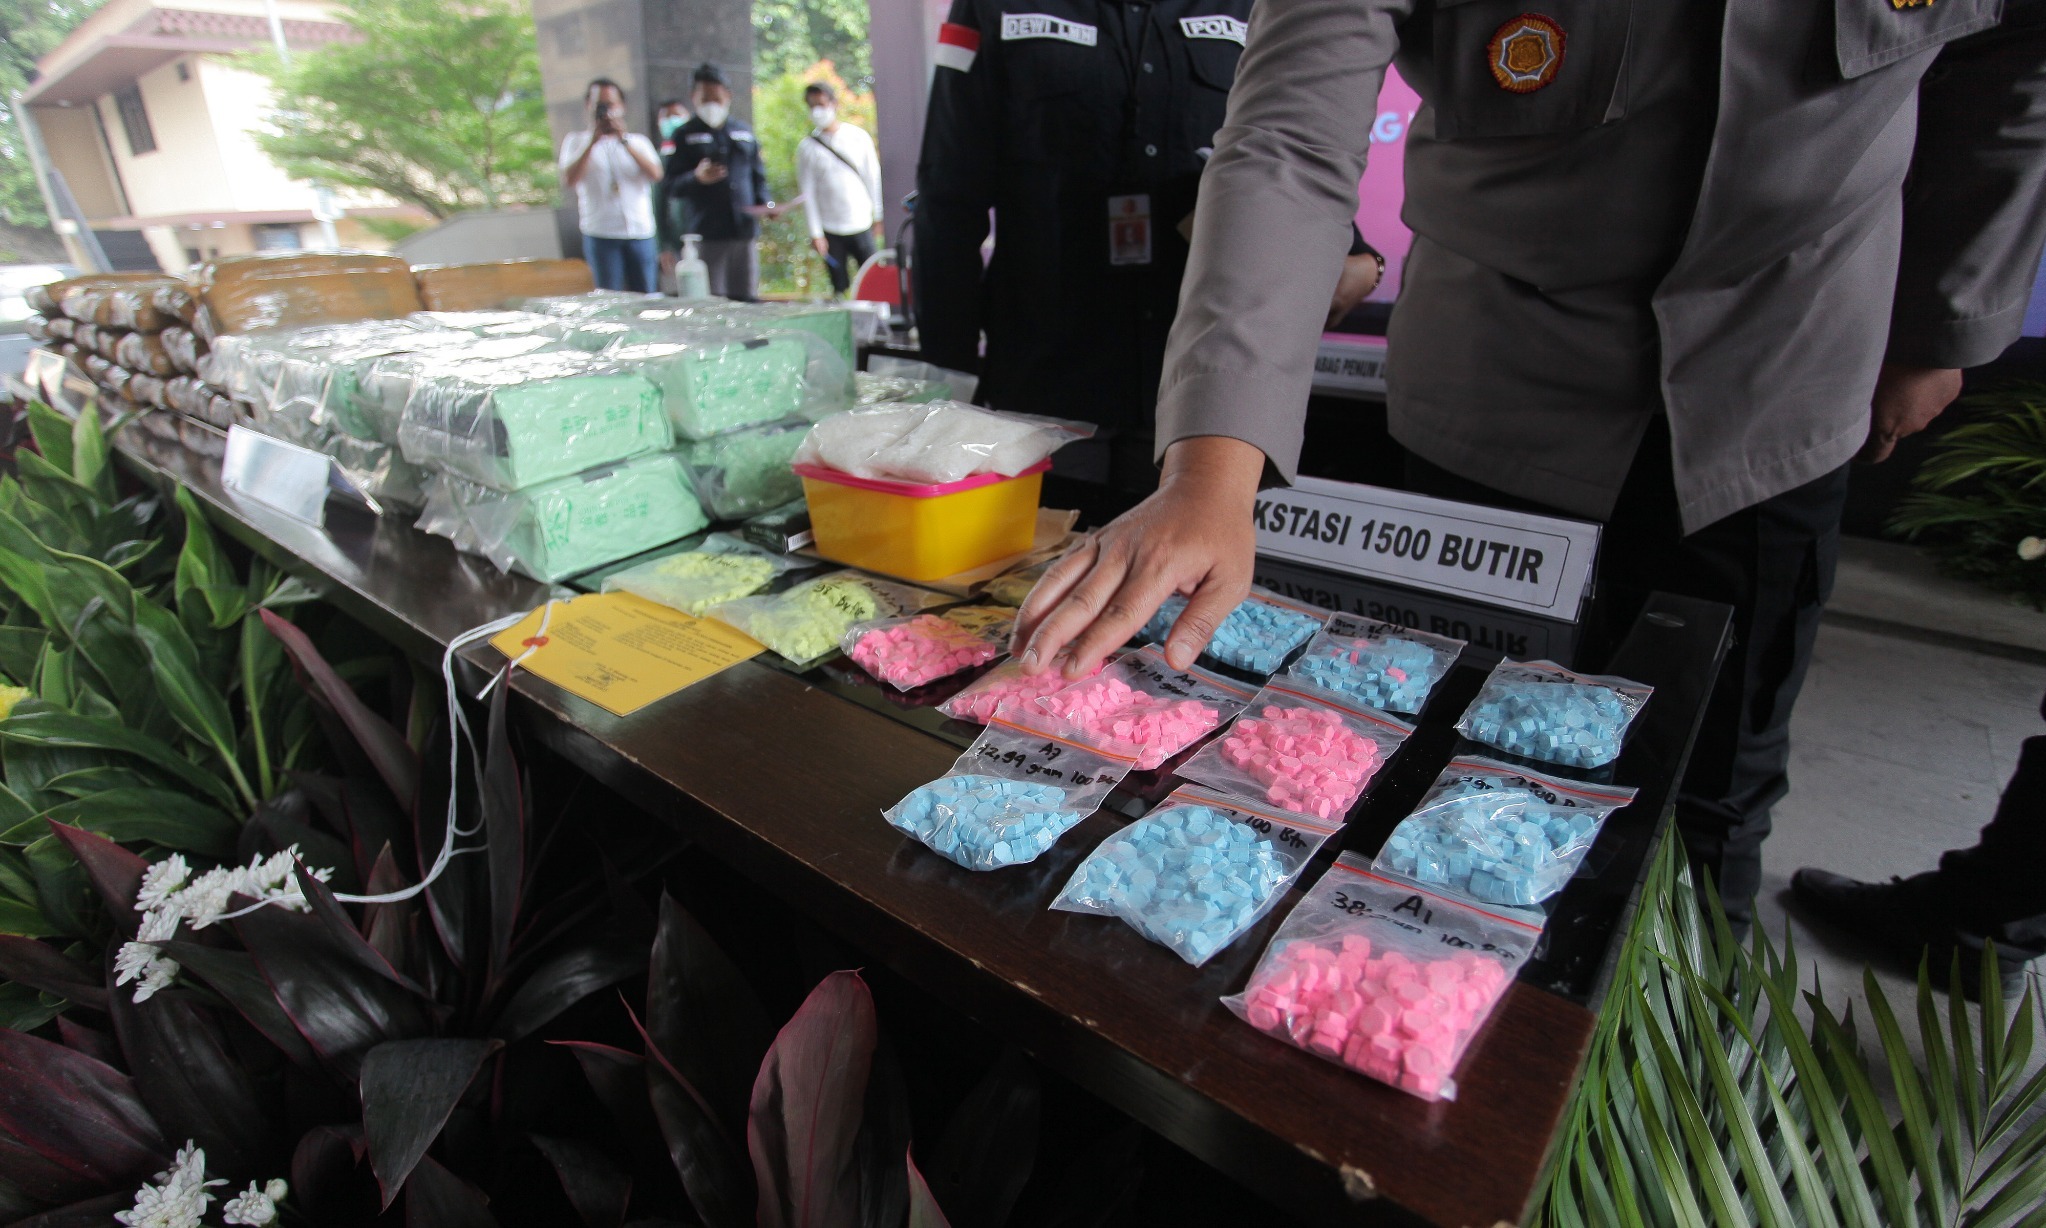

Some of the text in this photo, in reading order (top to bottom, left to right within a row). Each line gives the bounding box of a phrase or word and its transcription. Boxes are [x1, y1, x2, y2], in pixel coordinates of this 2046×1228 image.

[1007, 17, 1050, 37] DEWI
[1253, 499, 1544, 584] KSTASI 1500 BUTIR
[1025, 763, 1063, 779] gram
[1070, 770, 1095, 786] 100
[1244, 814, 1272, 834] 100
[1392, 894, 1433, 925] A1
